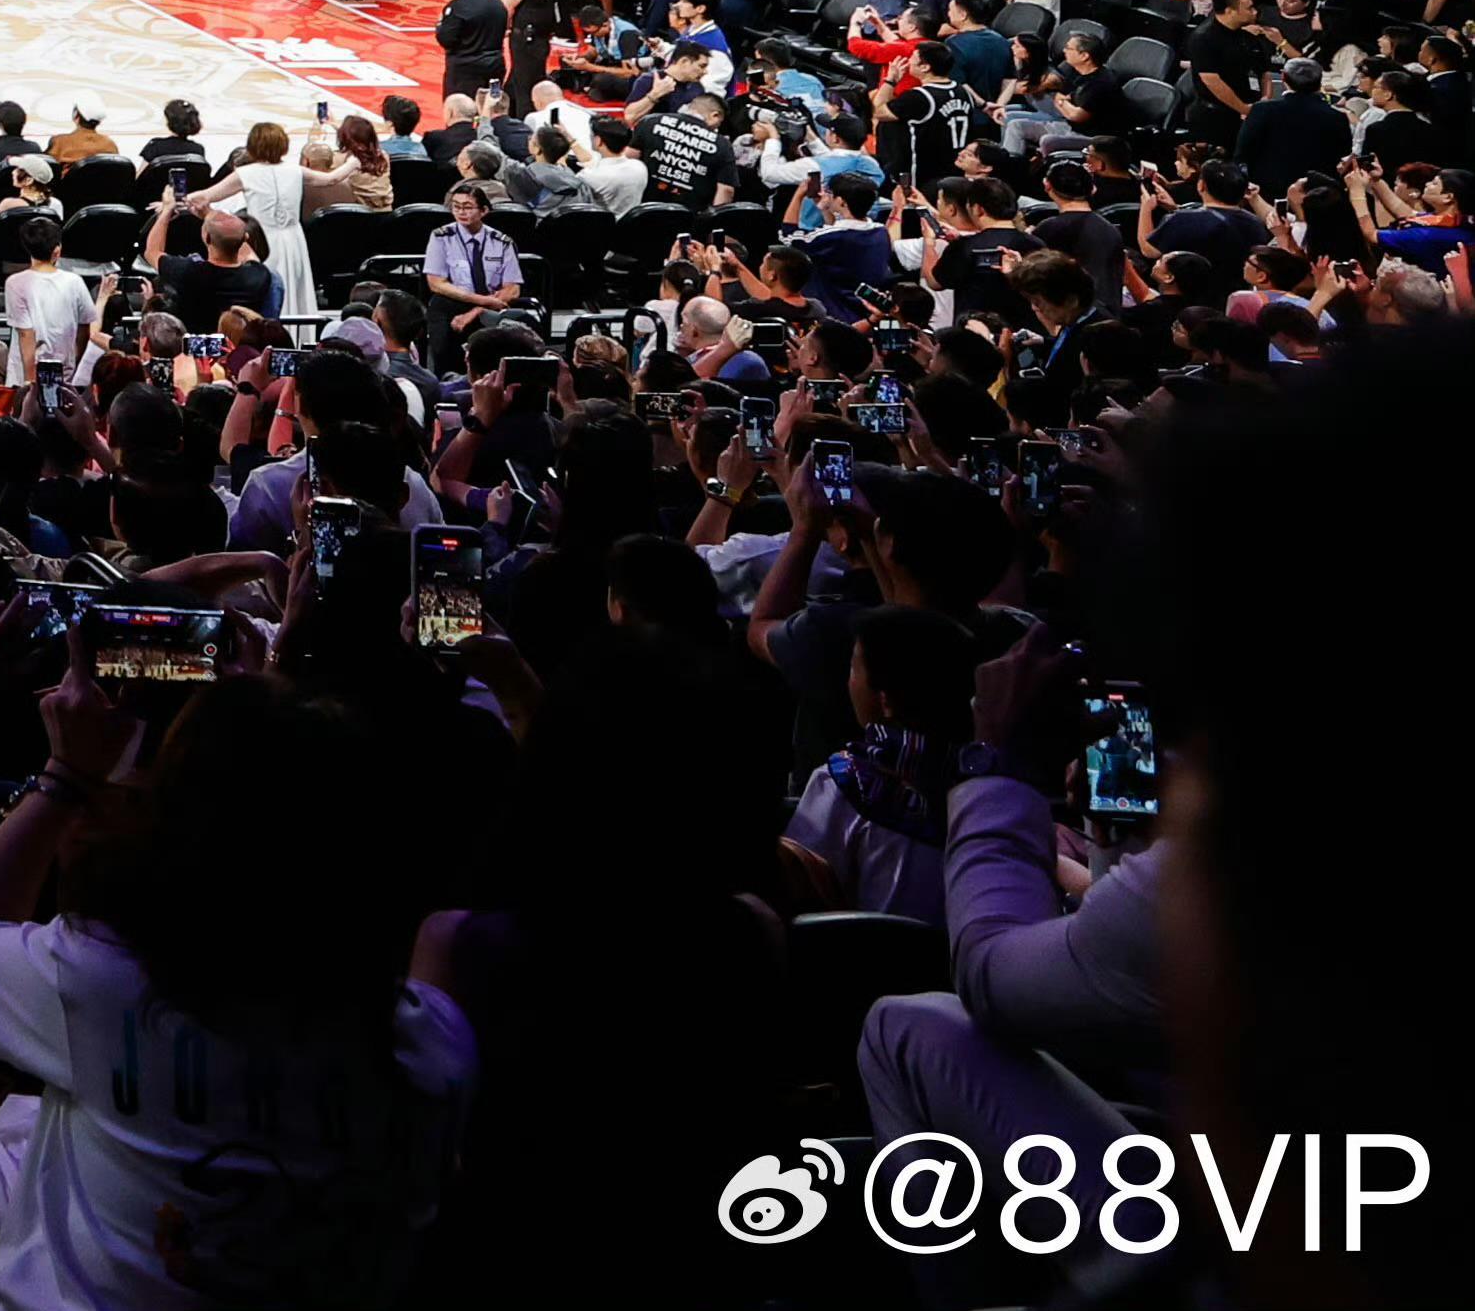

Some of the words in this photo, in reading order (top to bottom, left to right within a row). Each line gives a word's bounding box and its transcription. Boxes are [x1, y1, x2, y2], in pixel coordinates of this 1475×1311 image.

[652, 127, 718, 154] PREPARED
[661, 115, 677, 129] BE
[677, 120, 717, 142] MORE
[947, 116, 968, 149] 17
[649, 149, 708, 176] ANYONE
[664, 139, 701, 161] THAN
[658, 163, 693, 183] ELSE
